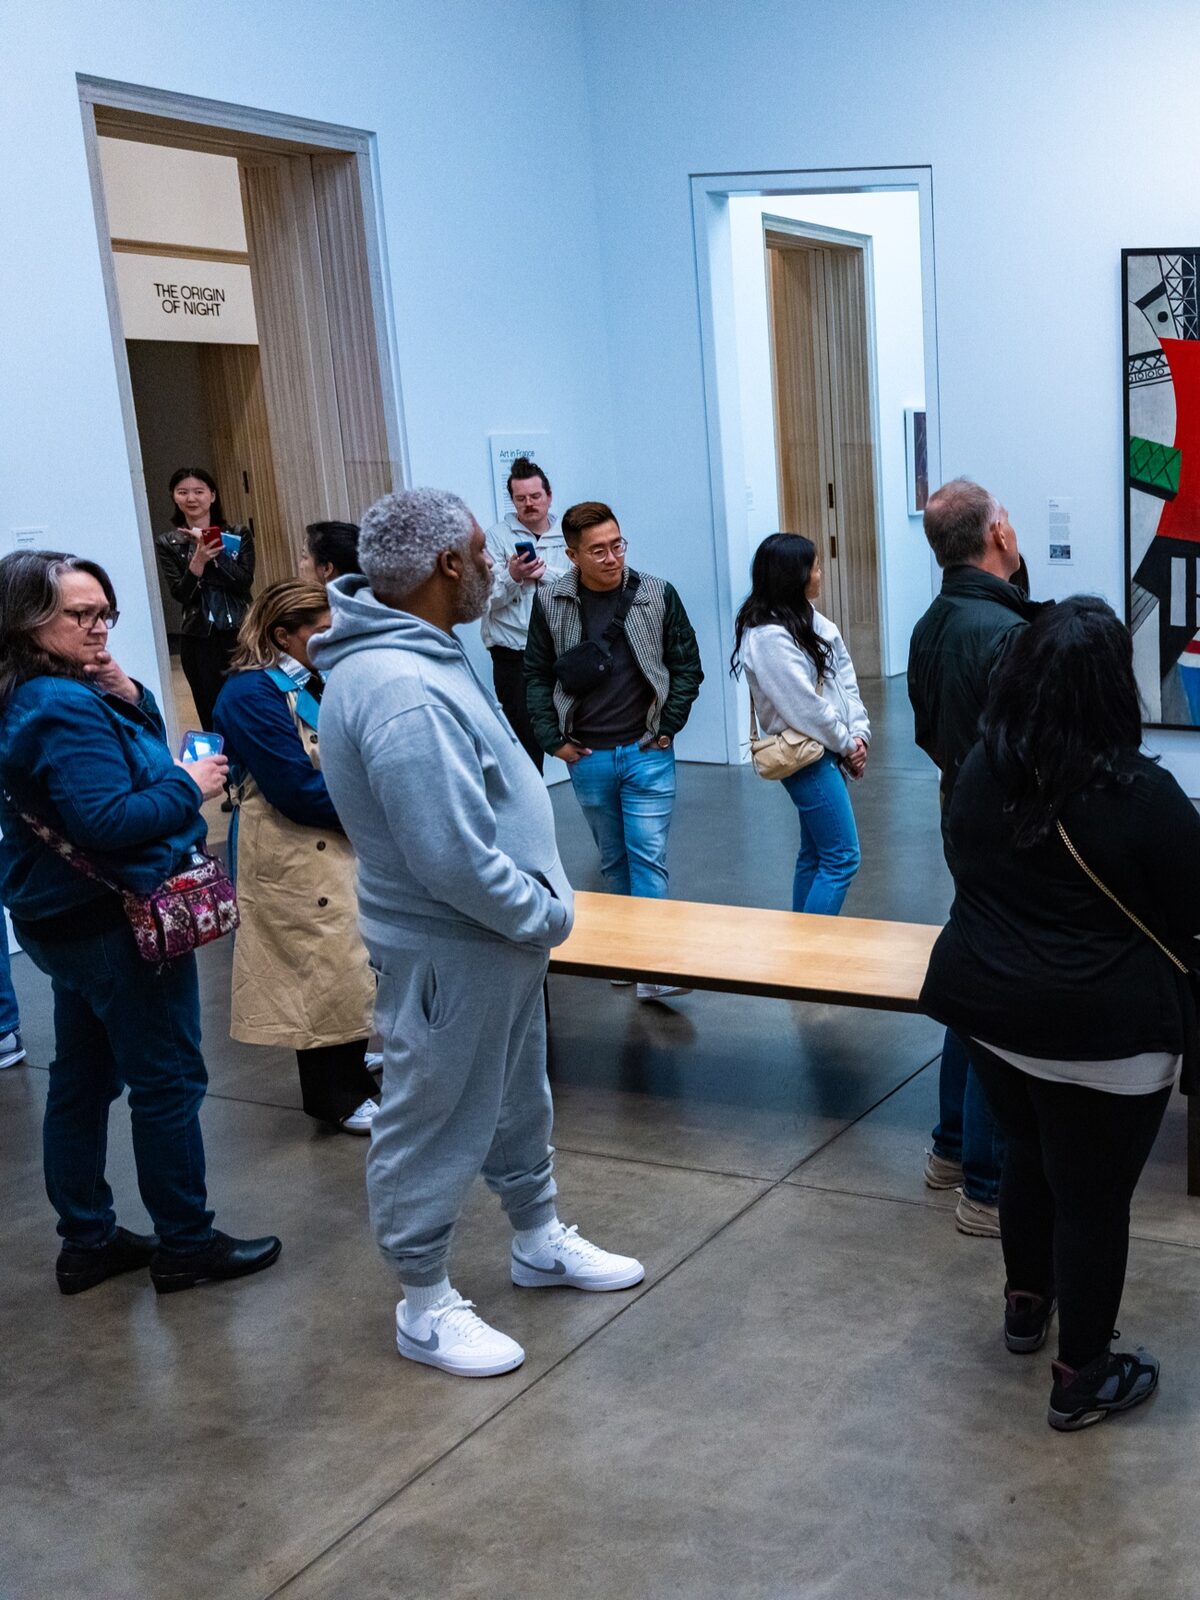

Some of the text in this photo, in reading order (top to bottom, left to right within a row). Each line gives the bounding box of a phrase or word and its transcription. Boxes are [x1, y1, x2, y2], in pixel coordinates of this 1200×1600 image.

[153, 283, 226, 302] THE ORIGIN
[162, 299, 221, 316] OF NIGHT
[499, 449, 536, 458] Art in France
